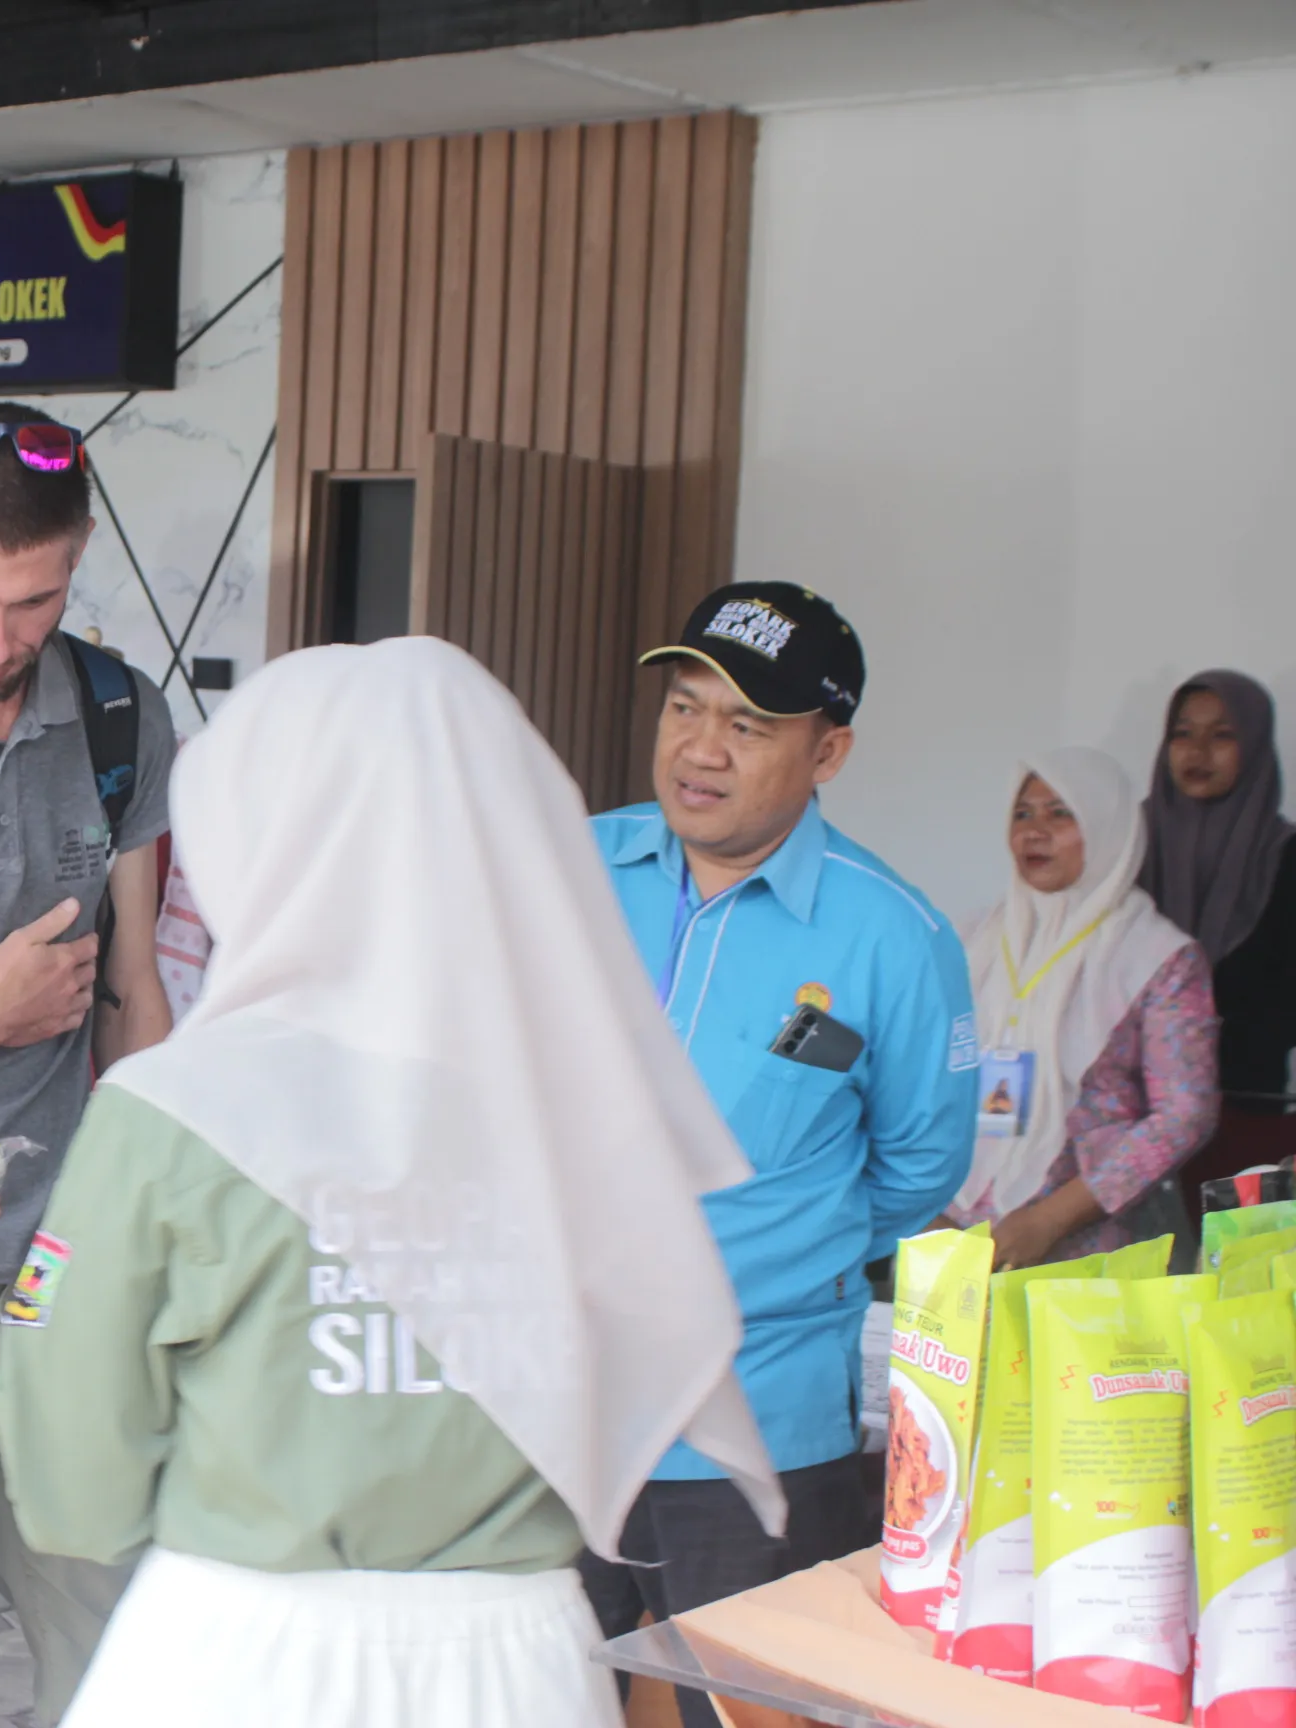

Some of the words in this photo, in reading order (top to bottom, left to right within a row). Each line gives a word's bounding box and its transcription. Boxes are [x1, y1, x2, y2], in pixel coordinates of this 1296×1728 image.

[720, 602, 796, 634] GEOPARK
[704, 620, 779, 659] SILOKEK
[923, 1340, 969, 1381] Uwo
[1092, 1371, 1168, 1398] Dunsanak
